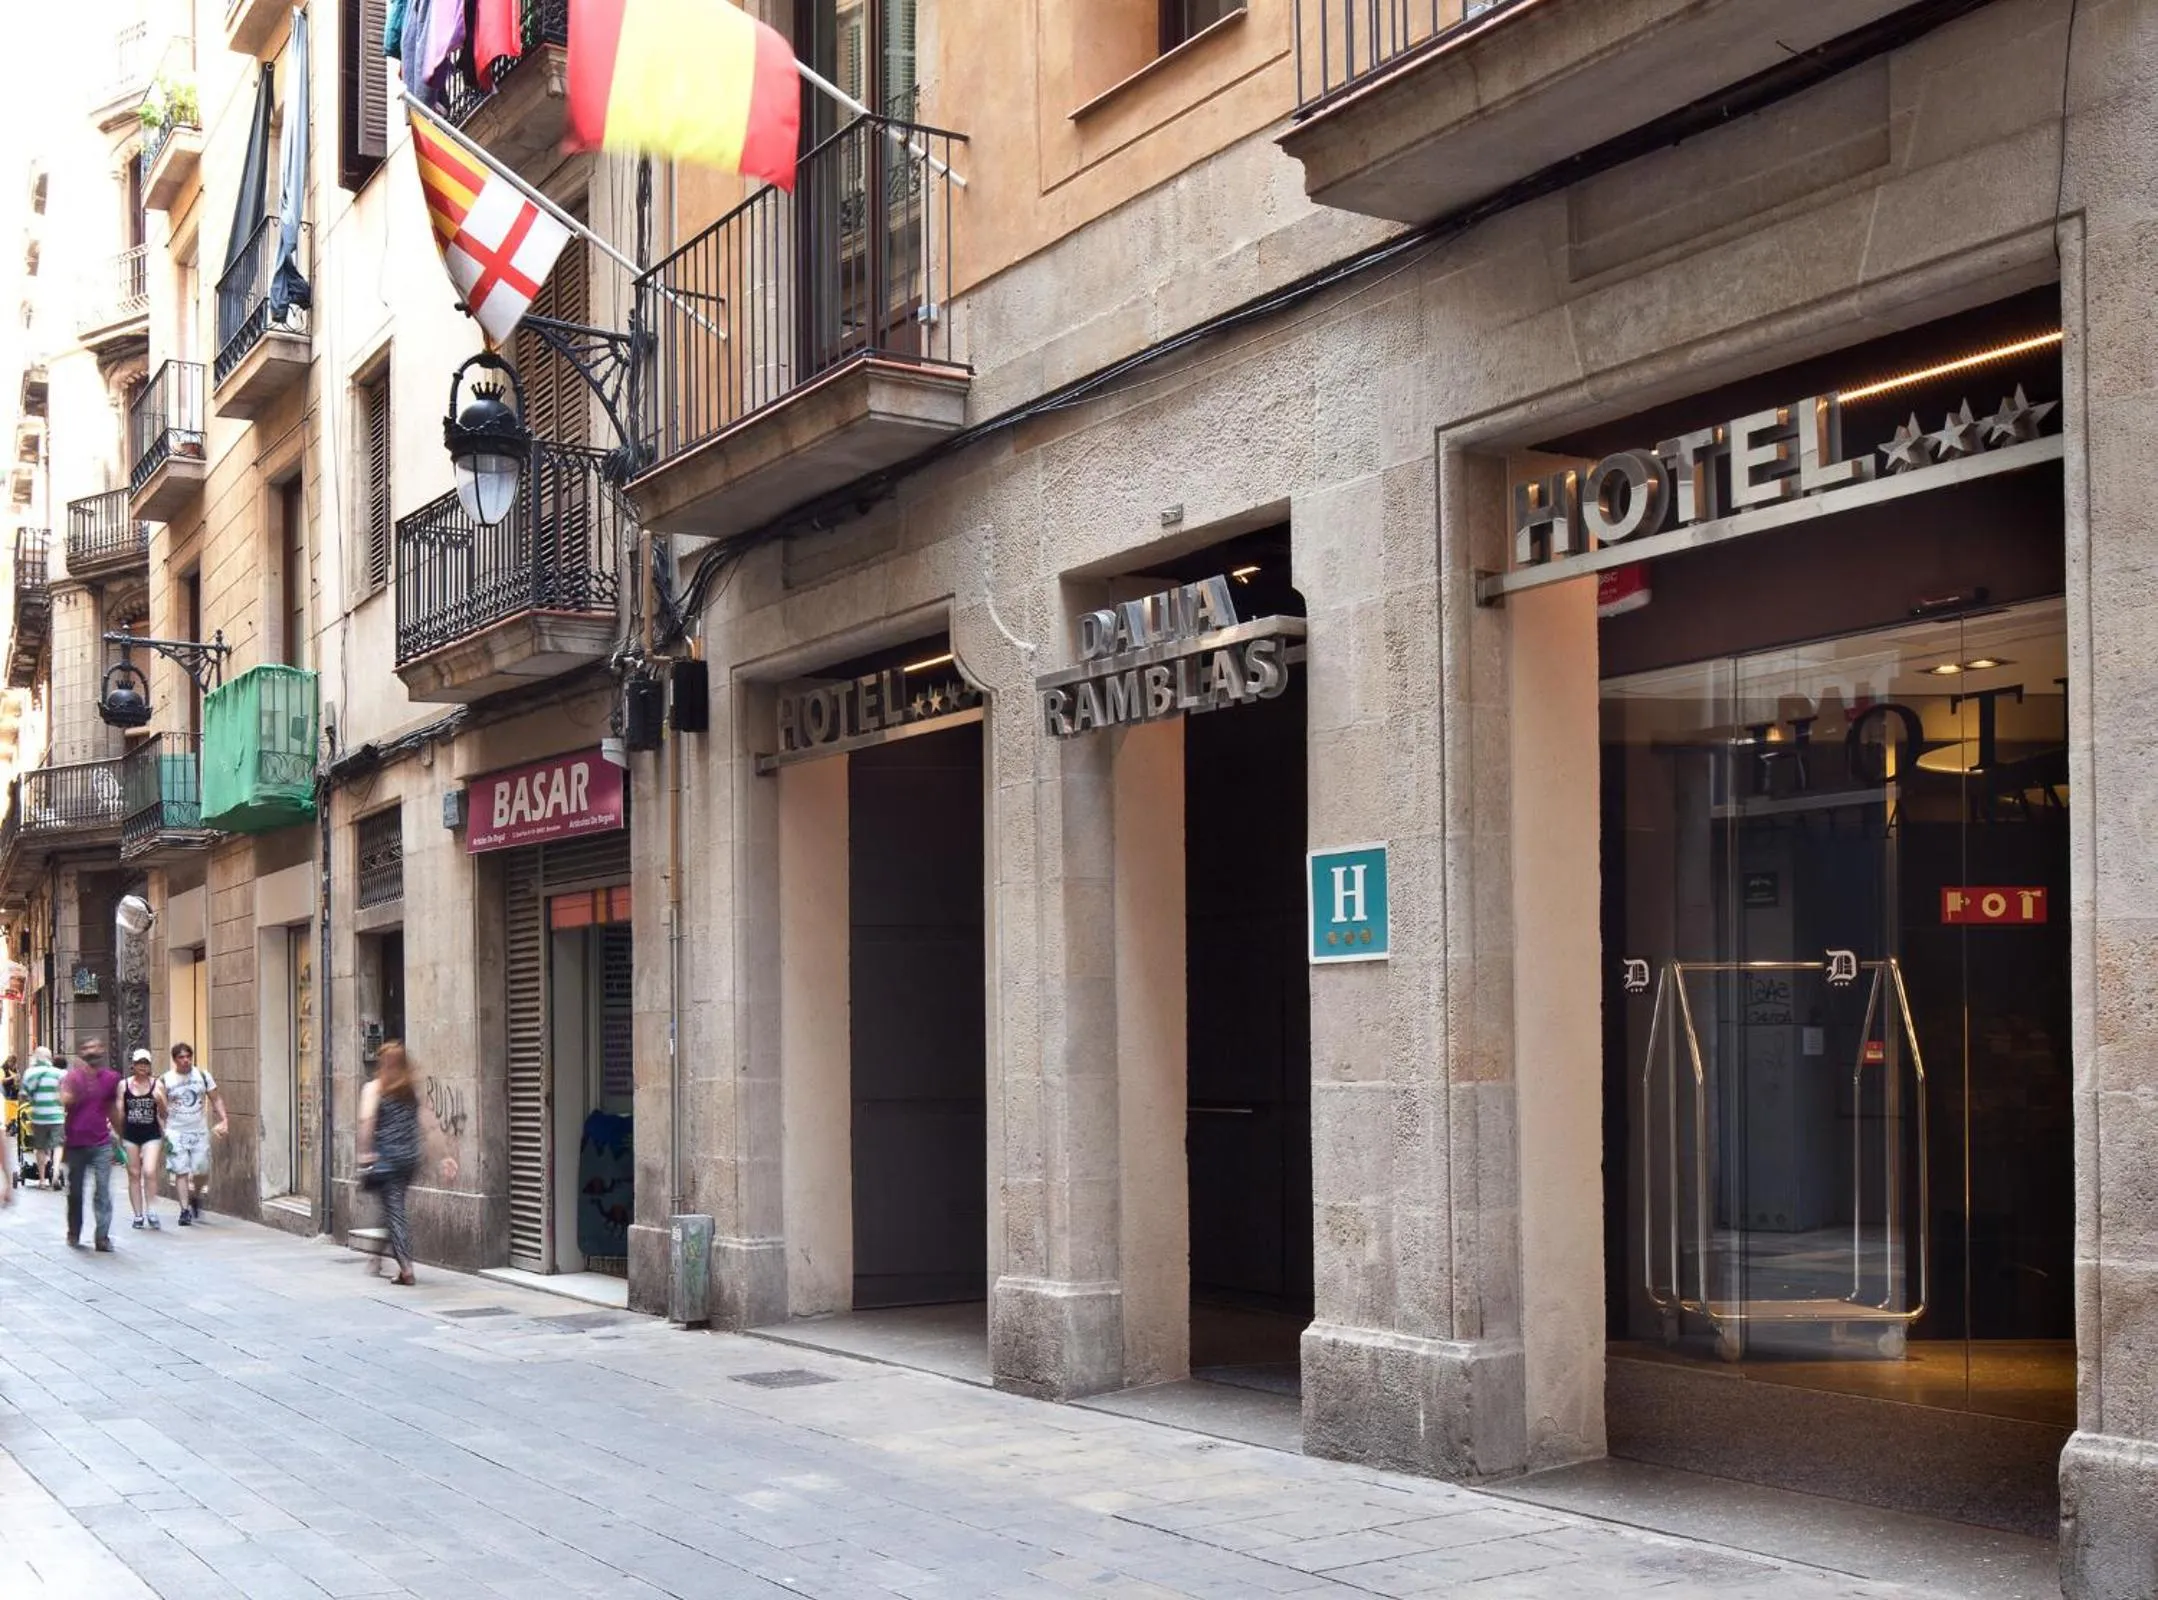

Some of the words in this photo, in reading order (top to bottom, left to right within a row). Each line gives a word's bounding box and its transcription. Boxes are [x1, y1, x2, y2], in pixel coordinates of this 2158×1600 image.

[1516, 394, 1868, 564] HOTEL
[1077, 575, 1238, 661] DALIA
[777, 668, 906, 750] HOTEL
[1044, 639, 1285, 736] RAMBLAS
[493, 762, 589, 828] BASAR
[1331, 864, 1367, 923] H
[1825, 949, 1857, 983] D
